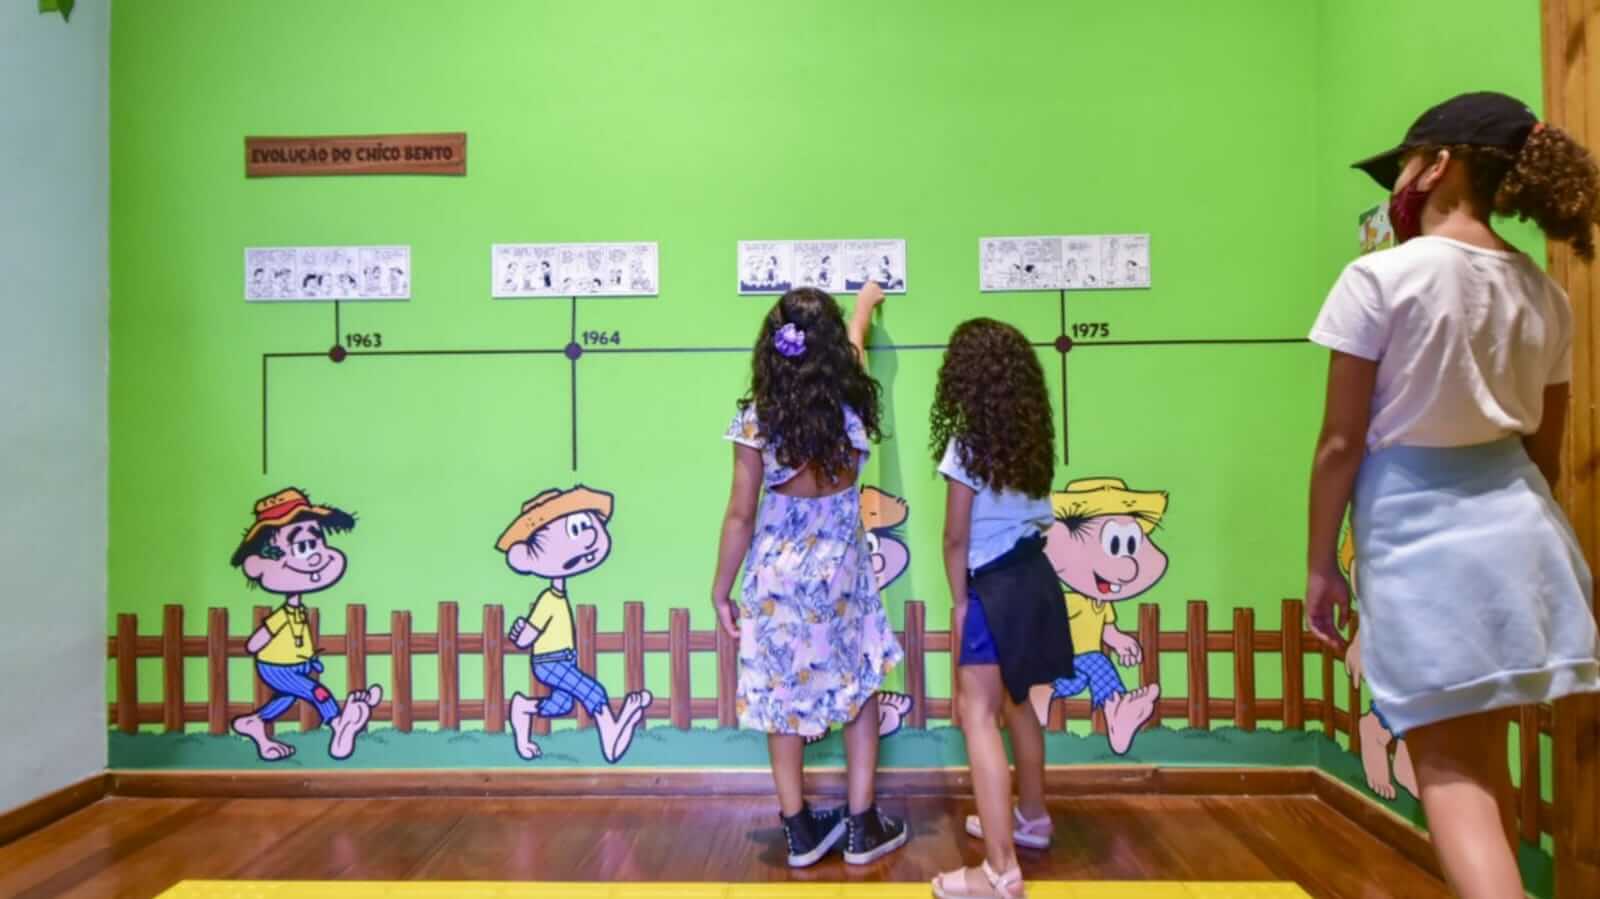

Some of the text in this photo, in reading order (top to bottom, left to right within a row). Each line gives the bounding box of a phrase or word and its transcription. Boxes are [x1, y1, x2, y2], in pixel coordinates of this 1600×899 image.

[332, 147, 353, 162] DO
[404, 146, 453, 161] BENTO
[582, 330, 621, 345] 1964
[1071, 322, 1110, 338] 1975
[345, 332, 382, 348] 1963
